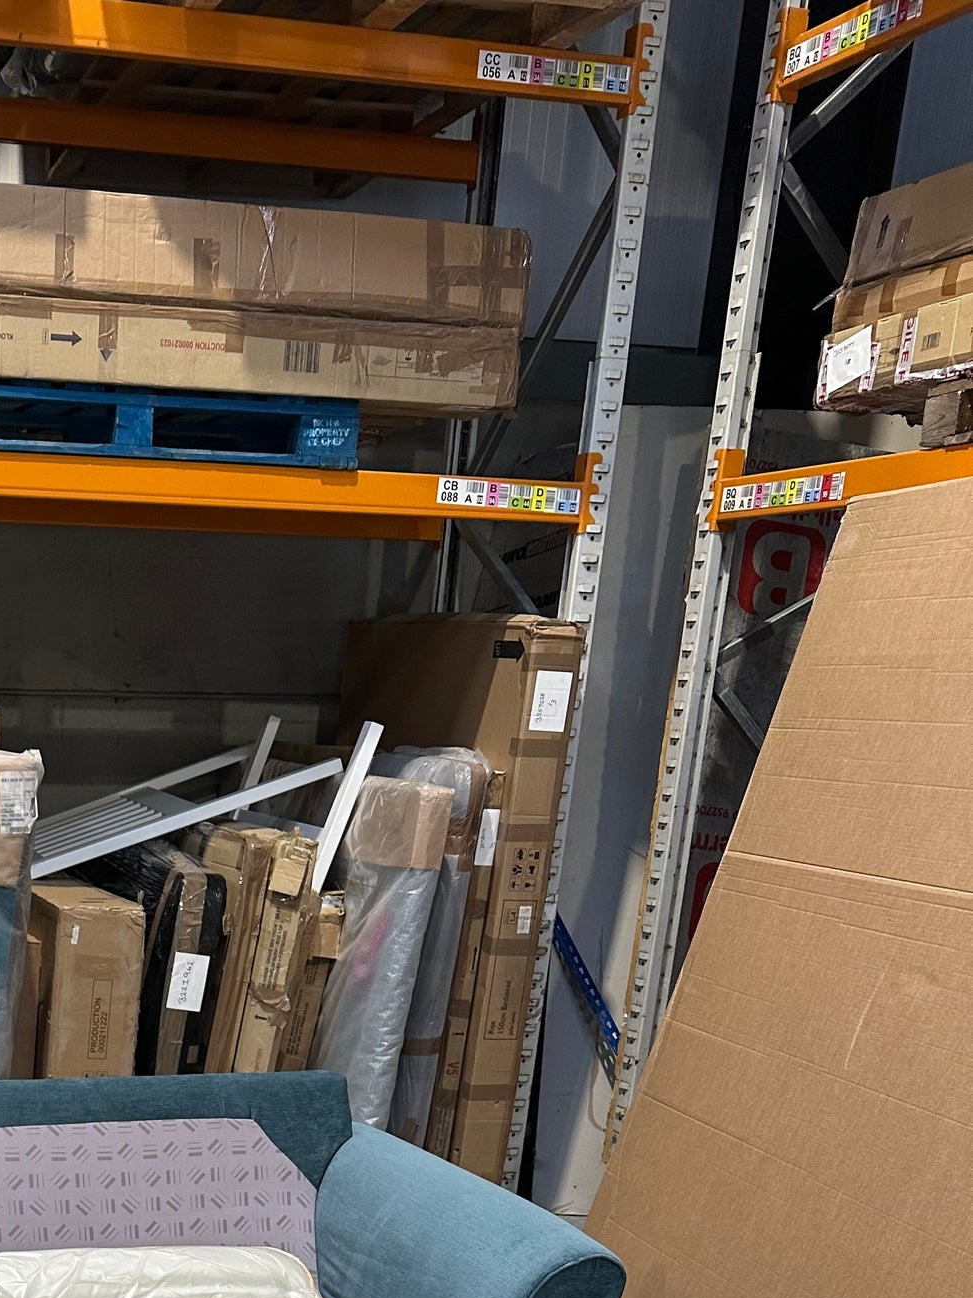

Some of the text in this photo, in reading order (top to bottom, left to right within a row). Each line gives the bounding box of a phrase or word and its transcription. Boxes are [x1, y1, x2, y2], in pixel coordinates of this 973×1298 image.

[862, 13, 869, 25] D
[879, 20, 885, 31] E
[824, 32, 831, 43] B
[840, 38, 847, 49] C
[789, 46, 801, 60] BQ
[484, 53, 501, 65] CC
[534, 58, 542, 68] B
[804, 55, 810, 66] A
[482, 66, 501, 78] 056
[584, 64, 592, 74] D
[787, 59, 800, 74] 007
[507, 69, 515, 80] A
[558, 75, 565, 85] C
[607, 80, 614, 90] E
[443, 480, 458, 491] CB
[490, 484, 497, 493] B
[757, 485, 762, 494] B
[789, 481, 796, 491] D
[441, 491, 458, 502] 088
[536, 488, 544, 497] D
[726, 488, 736, 499] BQ
[805, 492, 810, 501] E
[464, 495, 472, 504] A
[512, 499, 519, 507] C
[739, 500, 744, 509] A
[771, 496, 777, 505] C
[558, 503, 565, 511] E
[723, 500, 735, 511] 009
[89, 997, 101, 1053] PRODUCTION
